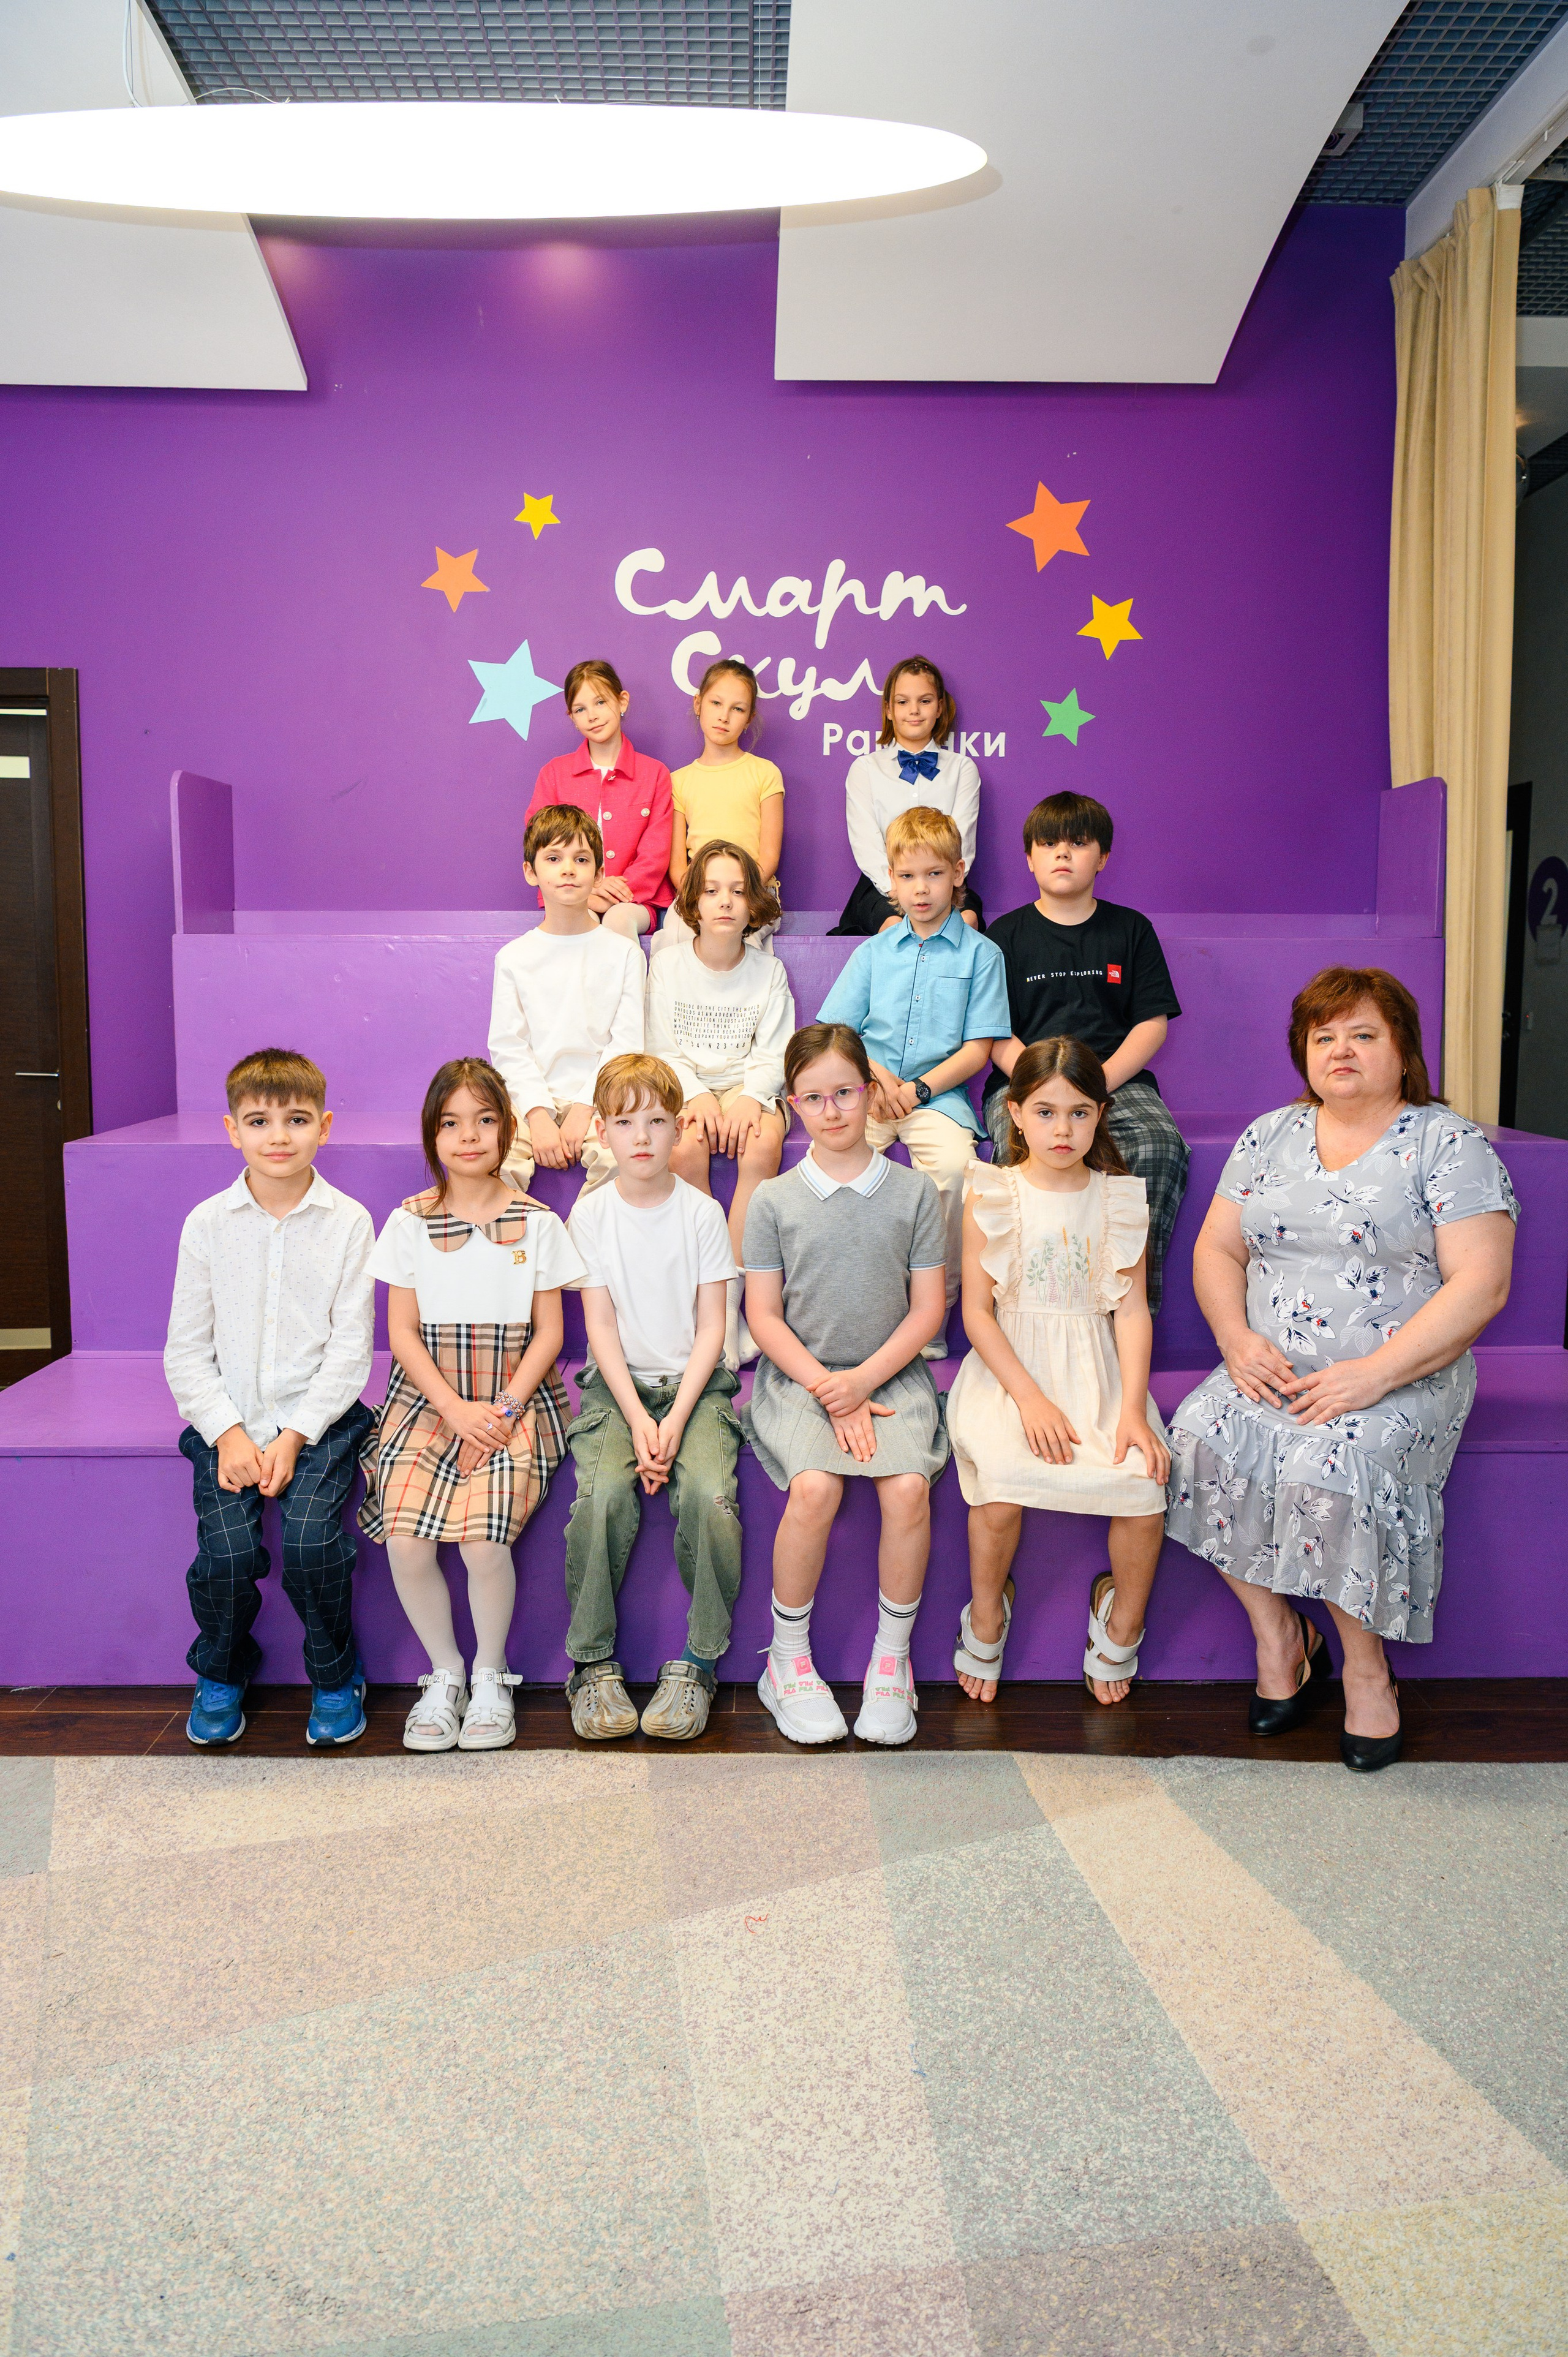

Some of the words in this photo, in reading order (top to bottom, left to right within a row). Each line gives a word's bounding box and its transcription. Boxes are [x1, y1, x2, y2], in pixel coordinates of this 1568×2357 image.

[614, 548, 967, 649] Смарт
[823, 722, 1006, 757] Раки
[1540, 878, 1558, 925] 2
[1027, 974, 1046, 982] NEVER
[675, 1001, 694, 1009] OUTSIDE
[675, 1006, 695, 1015] UNFOLDS
[511, 1250, 527, 1265] B
